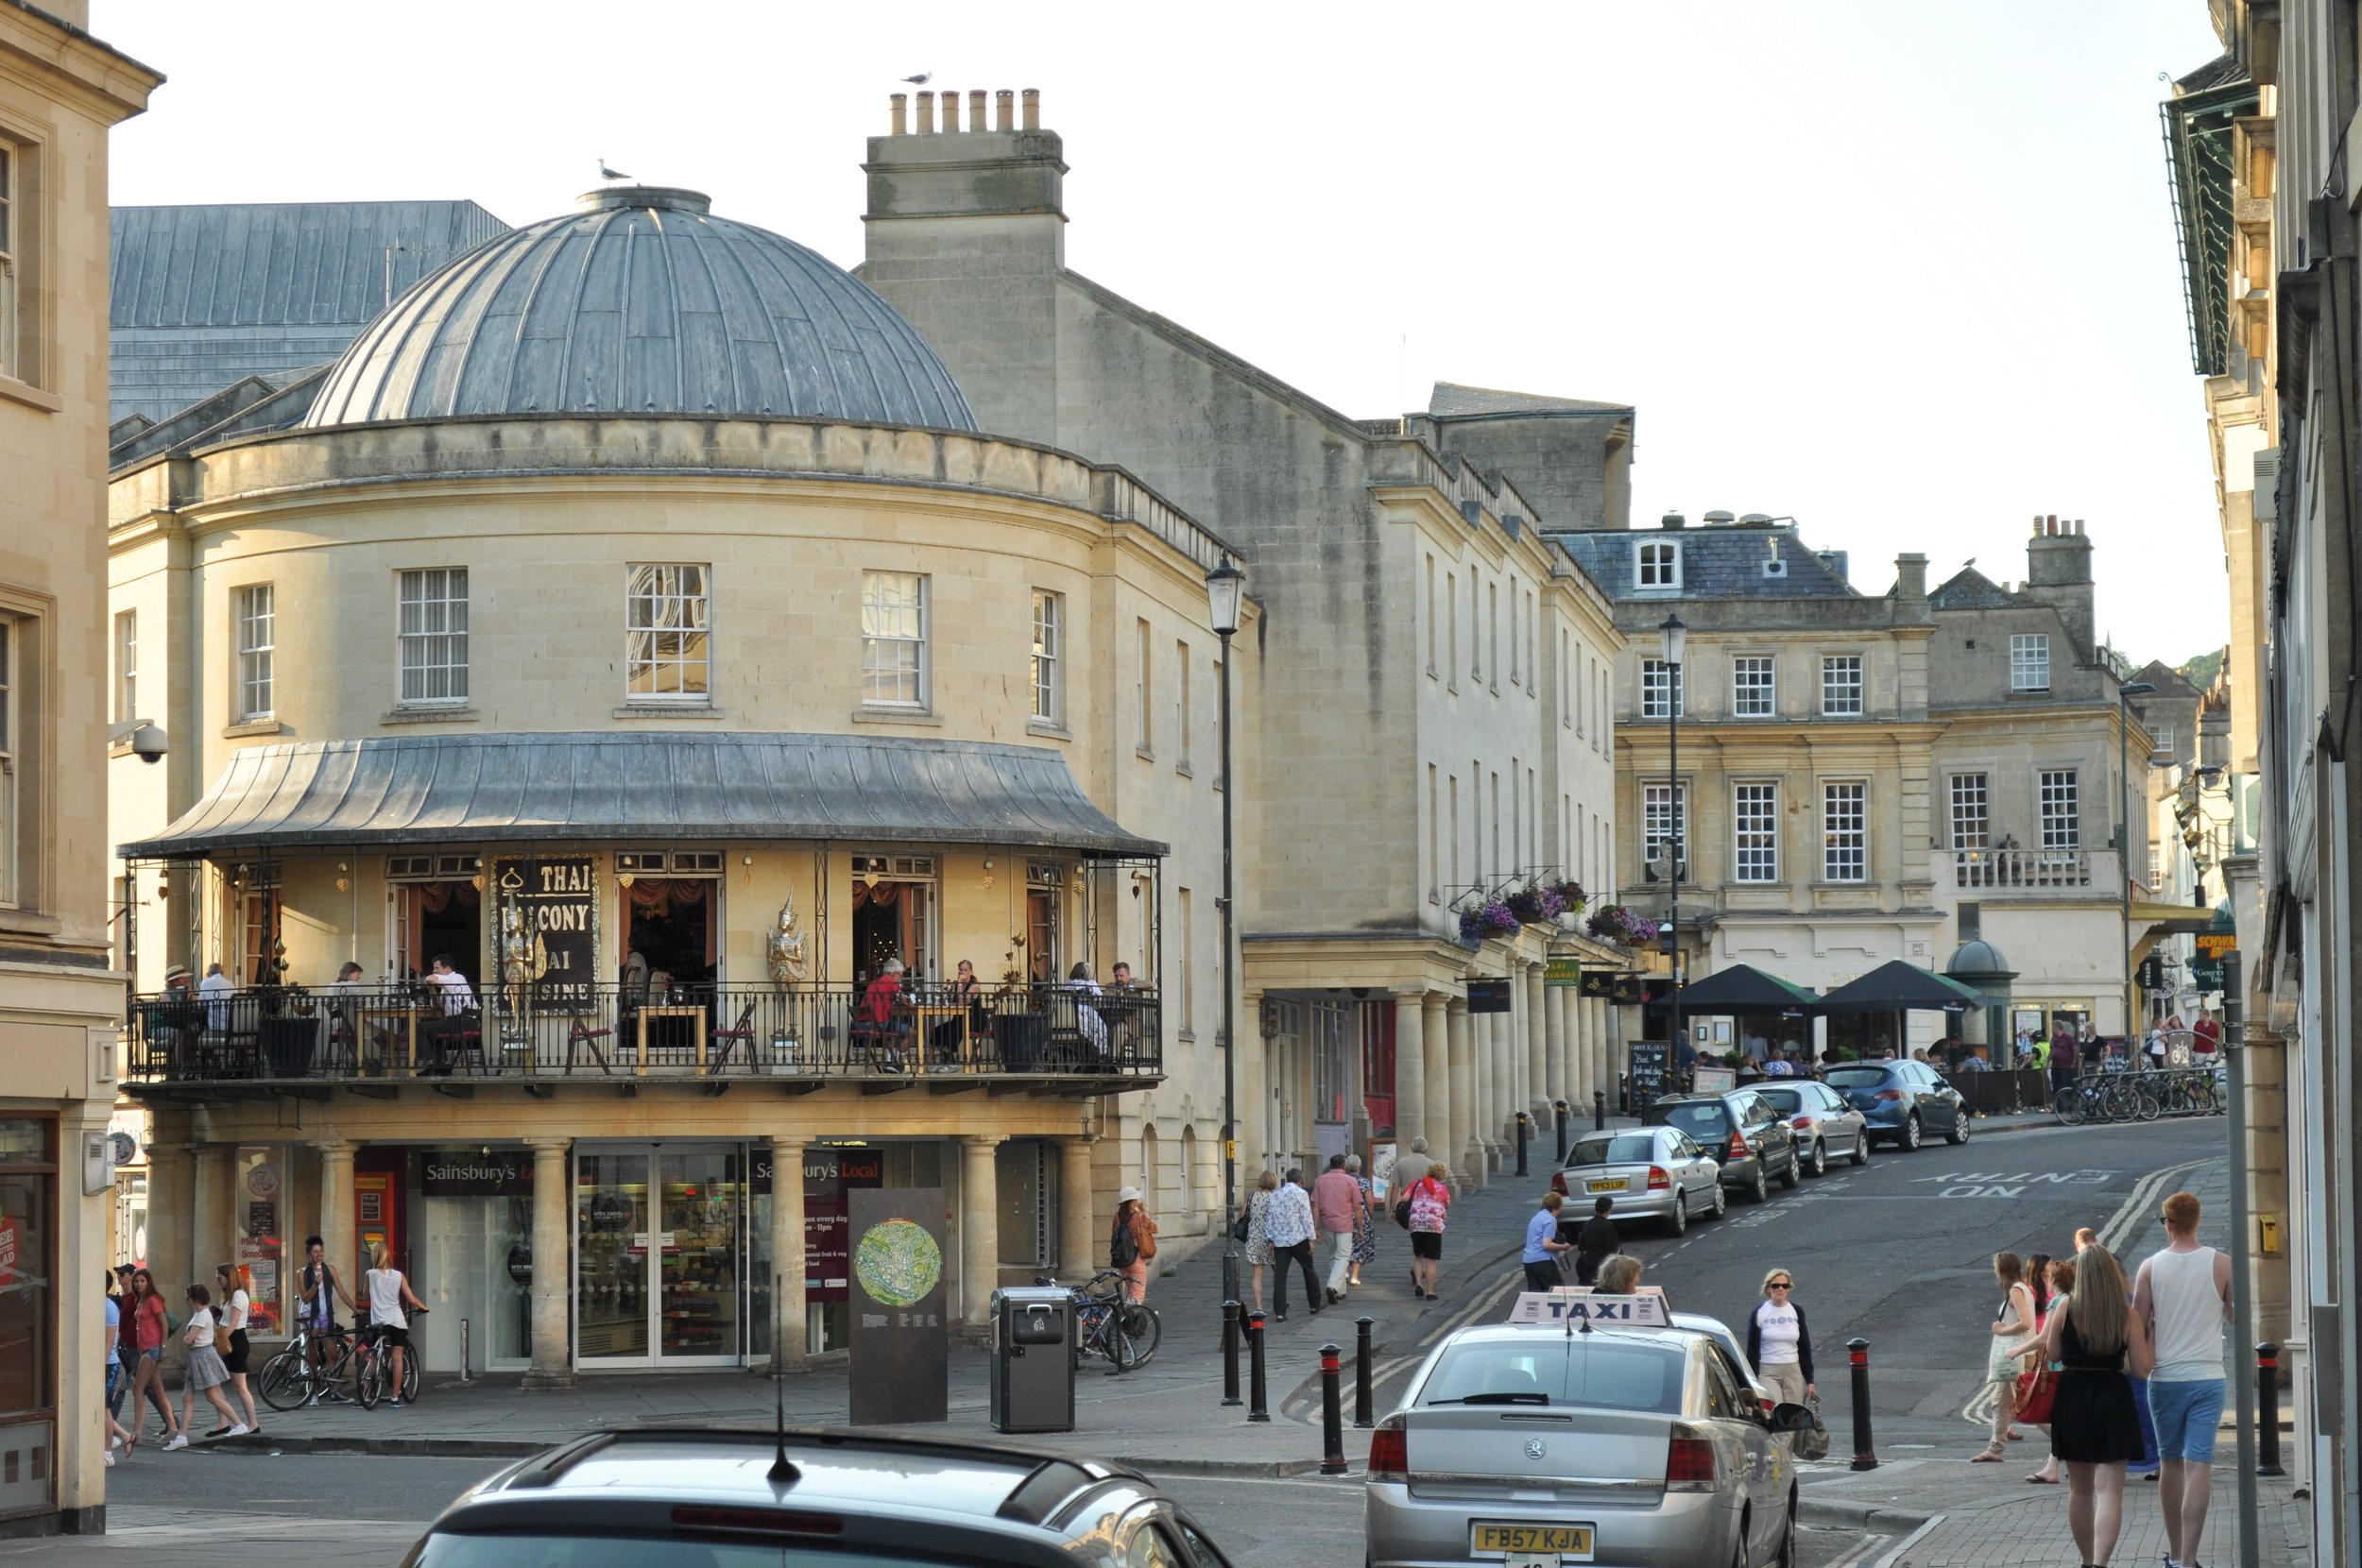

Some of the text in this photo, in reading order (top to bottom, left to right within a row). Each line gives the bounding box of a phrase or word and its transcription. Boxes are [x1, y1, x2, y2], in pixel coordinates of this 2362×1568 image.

[540, 865, 590, 893] THAI
[502, 904, 589, 933] CONY
[2197, 935, 2237, 948] SCHWA
[503, 983, 589, 1002] SINE
[426, 1164, 517, 1184] Sainsbury's
[756, 1162, 879, 1182] Saury's Local
[1910, 1169, 2124, 1184] ENTRY
[1591, 1181, 1626, 1191] YP53 LUF
[1938, 1185, 2028, 1199] NO
[816, 1216, 835, 1224] every
[835, 1215, 848, 1223] day
[1547, 1302, 1631, 1320] TAXI
[1484, 1527, 1583, 1550] FB57 KJA
